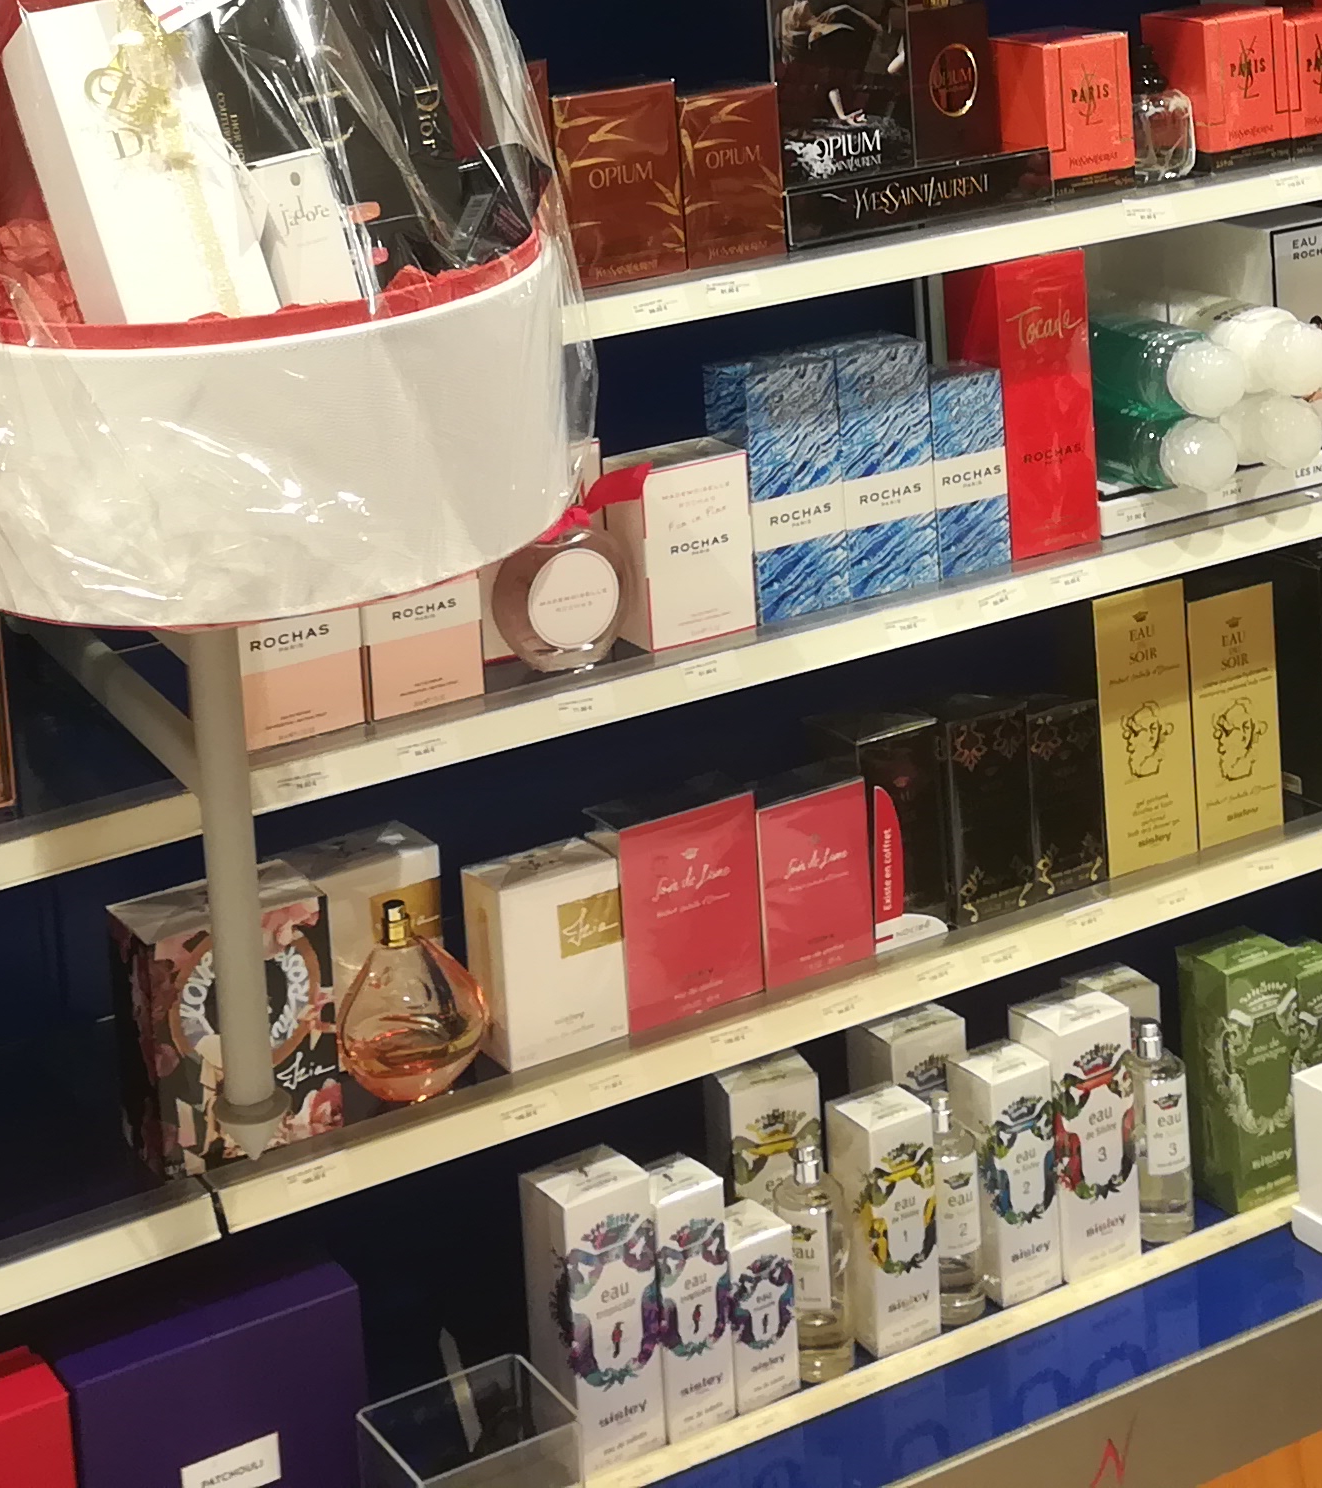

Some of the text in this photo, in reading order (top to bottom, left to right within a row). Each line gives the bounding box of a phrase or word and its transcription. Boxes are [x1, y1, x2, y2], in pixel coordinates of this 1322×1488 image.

[1071, 83, 1110, 103] PARIS
[413, 84, 441, 152] Dior
[813, 129, 881, 162] OPIUM
[706, 146, 761, 170] OPIUM
[588, 161, 654, 189] OPIUM
[1292, 236, 1317, 250] EAU
[942, 466, 1002, 487] ROCHAS
[1295, 466, 1312, 479] LES
[859, 482, 922, 505] ROCHAS
[769, 502, 832, 527] ROCHAS
[670, 533, 730, 556] ROCHAS
[392, 598, 457, 621] ROCHAS
[250, 623, 330, 653] ROCHAS
[1129, 624, 1155, 643] EAU
[1221, 631, 1246, 647] EAU
[1129, 647, 1158, 665] SOIR
[1221, 653, 1250, 671] SOIR
[882, 827, 893, 864] coffret
[882, 882, 893, 912] Existe
[1088, 1105, 1114, 1127] eau
[1157, 1112, 1183, 1128] eau
[1015, 1147, 1038, 1164] eau
[1097, 1146, 1108, 1162] 3
[894, 1194, 917, 1214] eau
[948, 1190, 974, 1208] eau
